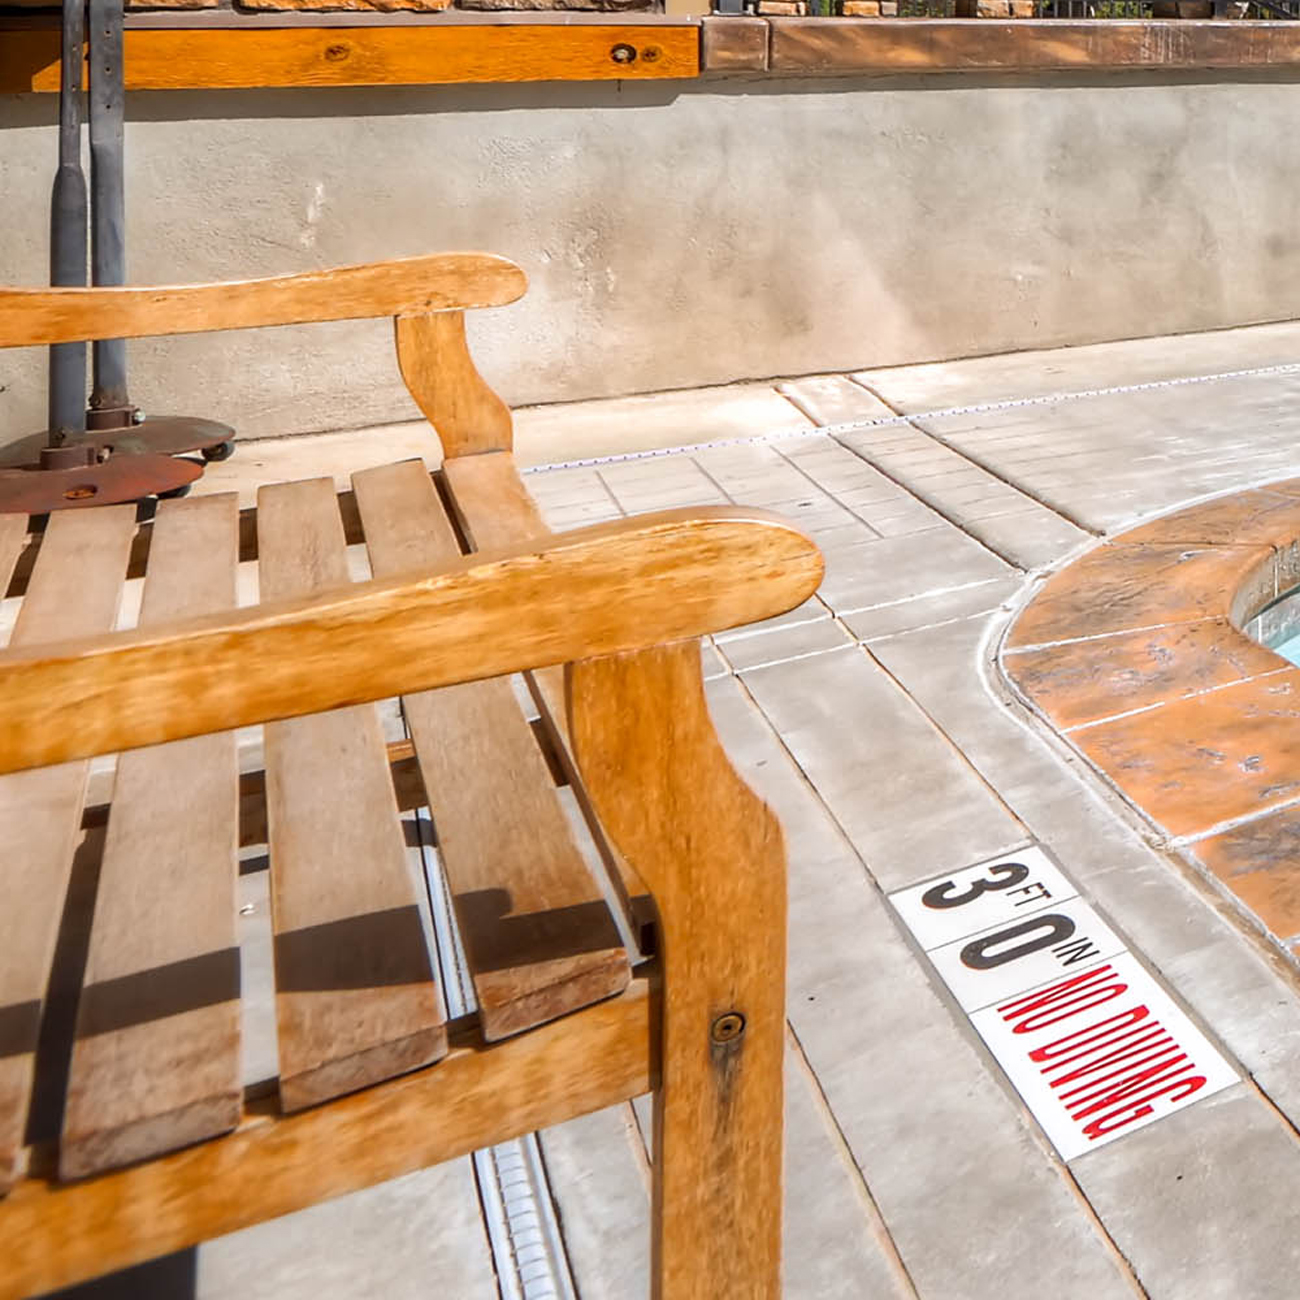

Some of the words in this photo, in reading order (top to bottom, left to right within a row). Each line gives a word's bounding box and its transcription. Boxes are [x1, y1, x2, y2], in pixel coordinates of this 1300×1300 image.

[920, 862, 1030, 910] 3
[1006, 882, 1052, 907] FT
[960, 913, 1076, 971] 0
[1050, 937, 1100, 967] IN
[997, 964, 1128, 1034] NO
[1028, 1004, 1207, 1141] DIVING
